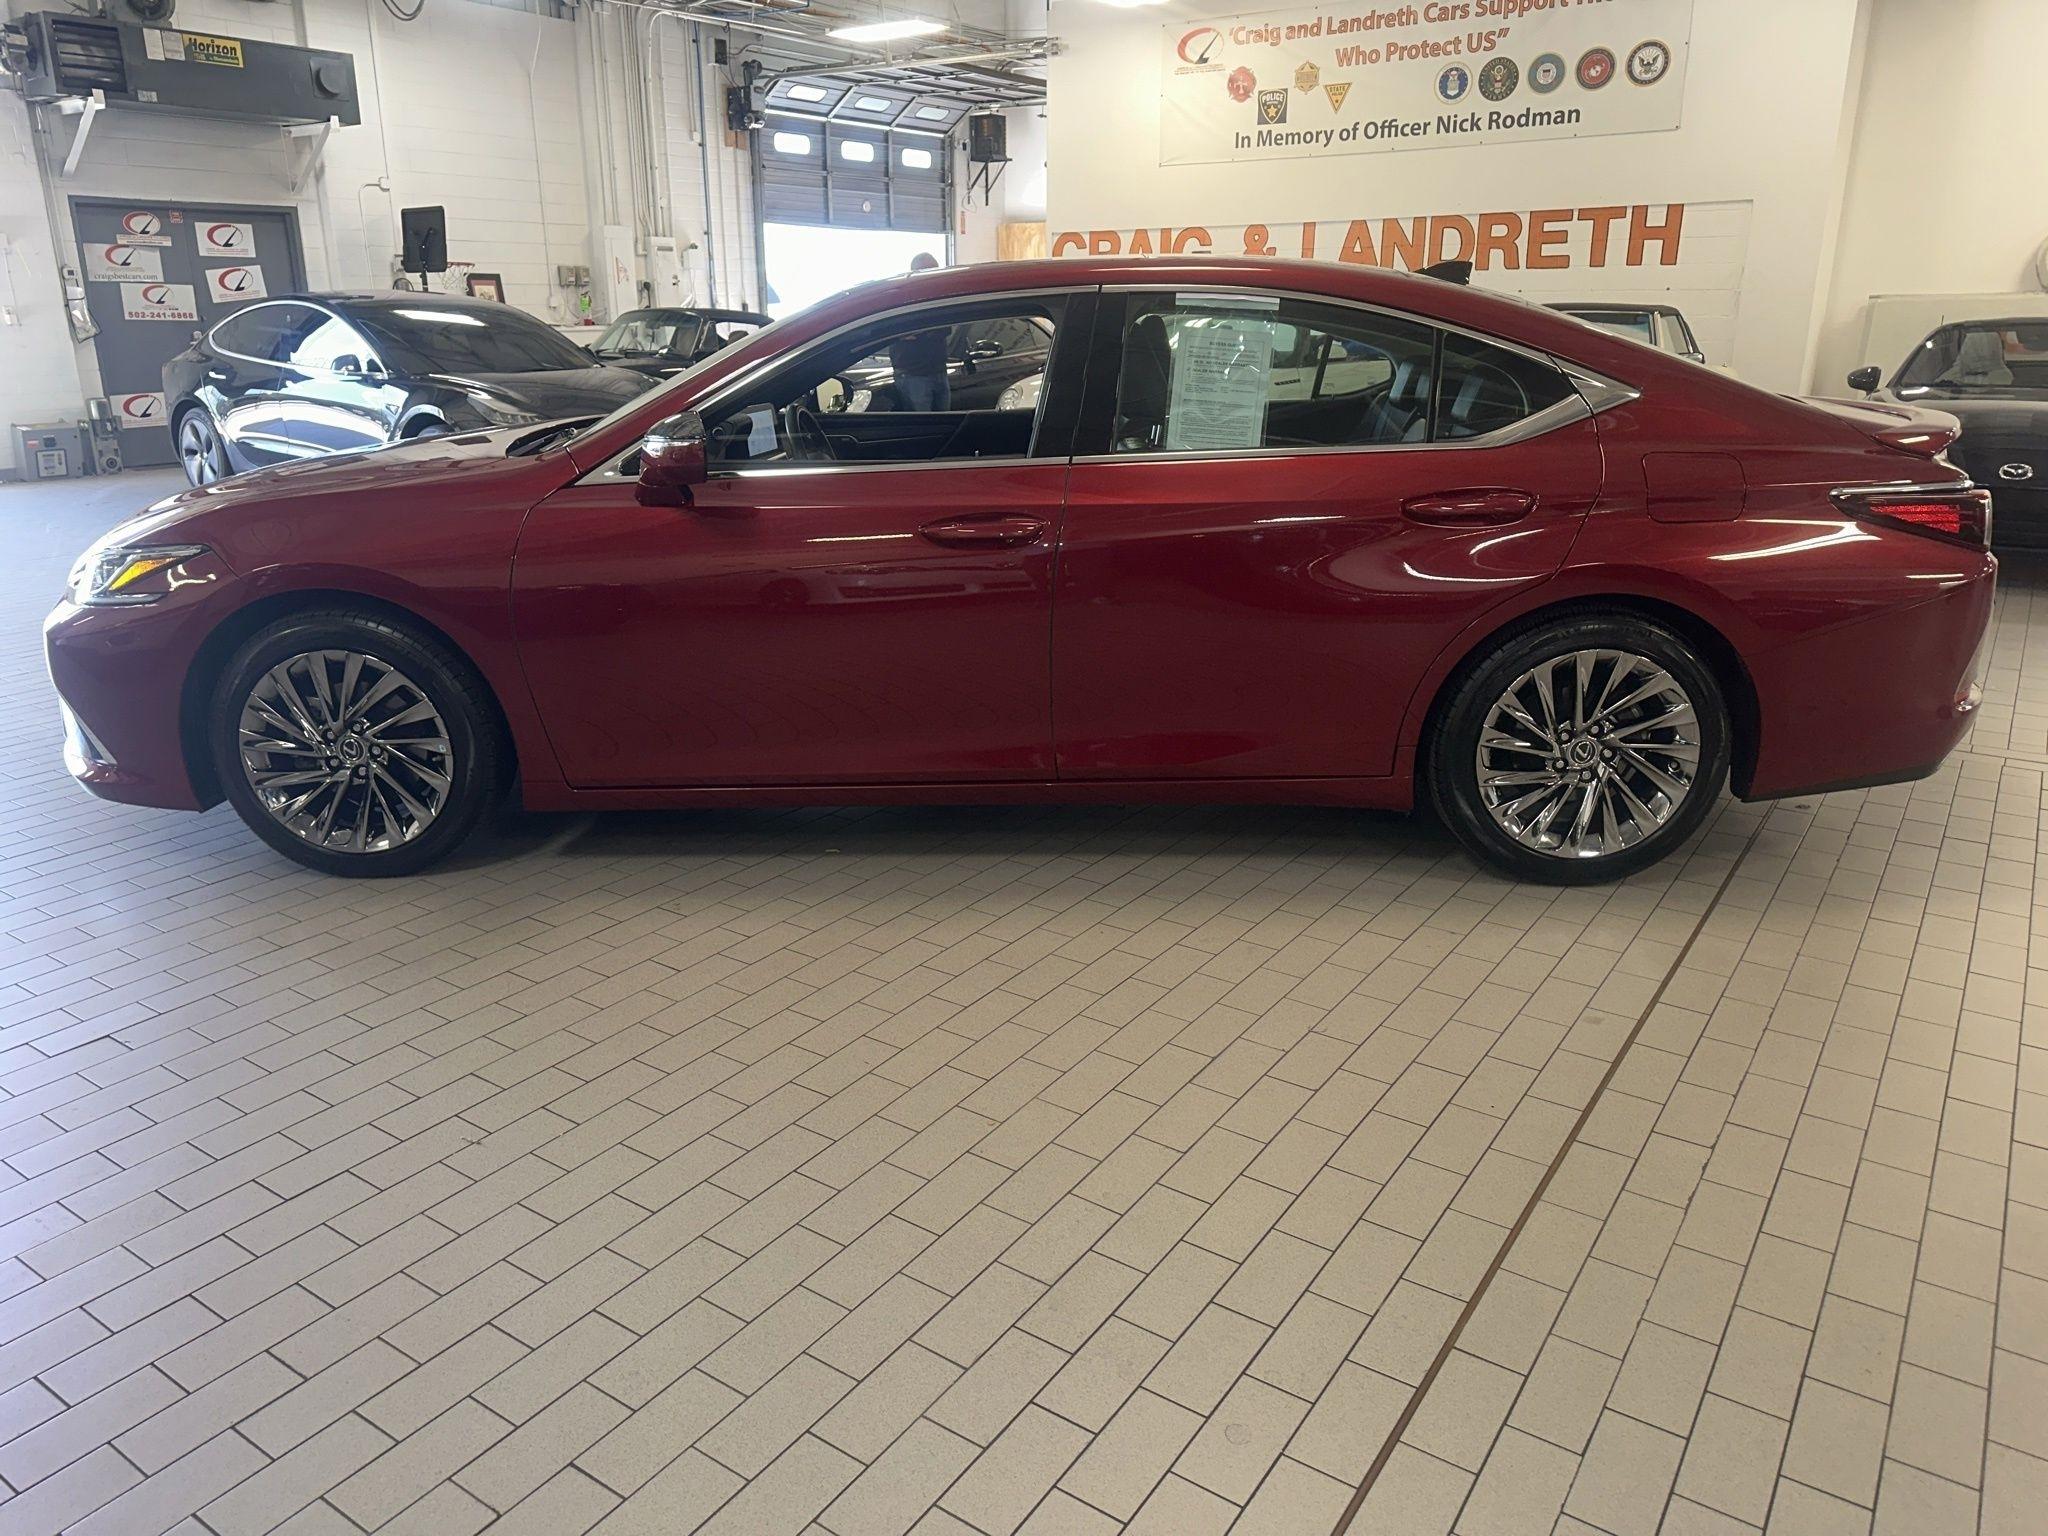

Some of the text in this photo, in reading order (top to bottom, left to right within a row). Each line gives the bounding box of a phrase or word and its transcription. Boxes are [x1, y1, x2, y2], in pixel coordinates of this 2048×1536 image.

[1285, 17, 1322, 40] and
[1326, 5, 1418, 35] Landreth
[1423, 2, 1470, 23] Cars
[188, 37, 237, 56] Horizon
[1335, 45, 1381, 67] Who
[1385, 36, 1462, 62] Protect
[1234, 107, 1581, 149] In Memory of Officer Nick Rodman
[1243, 224, 1277, 257] &
